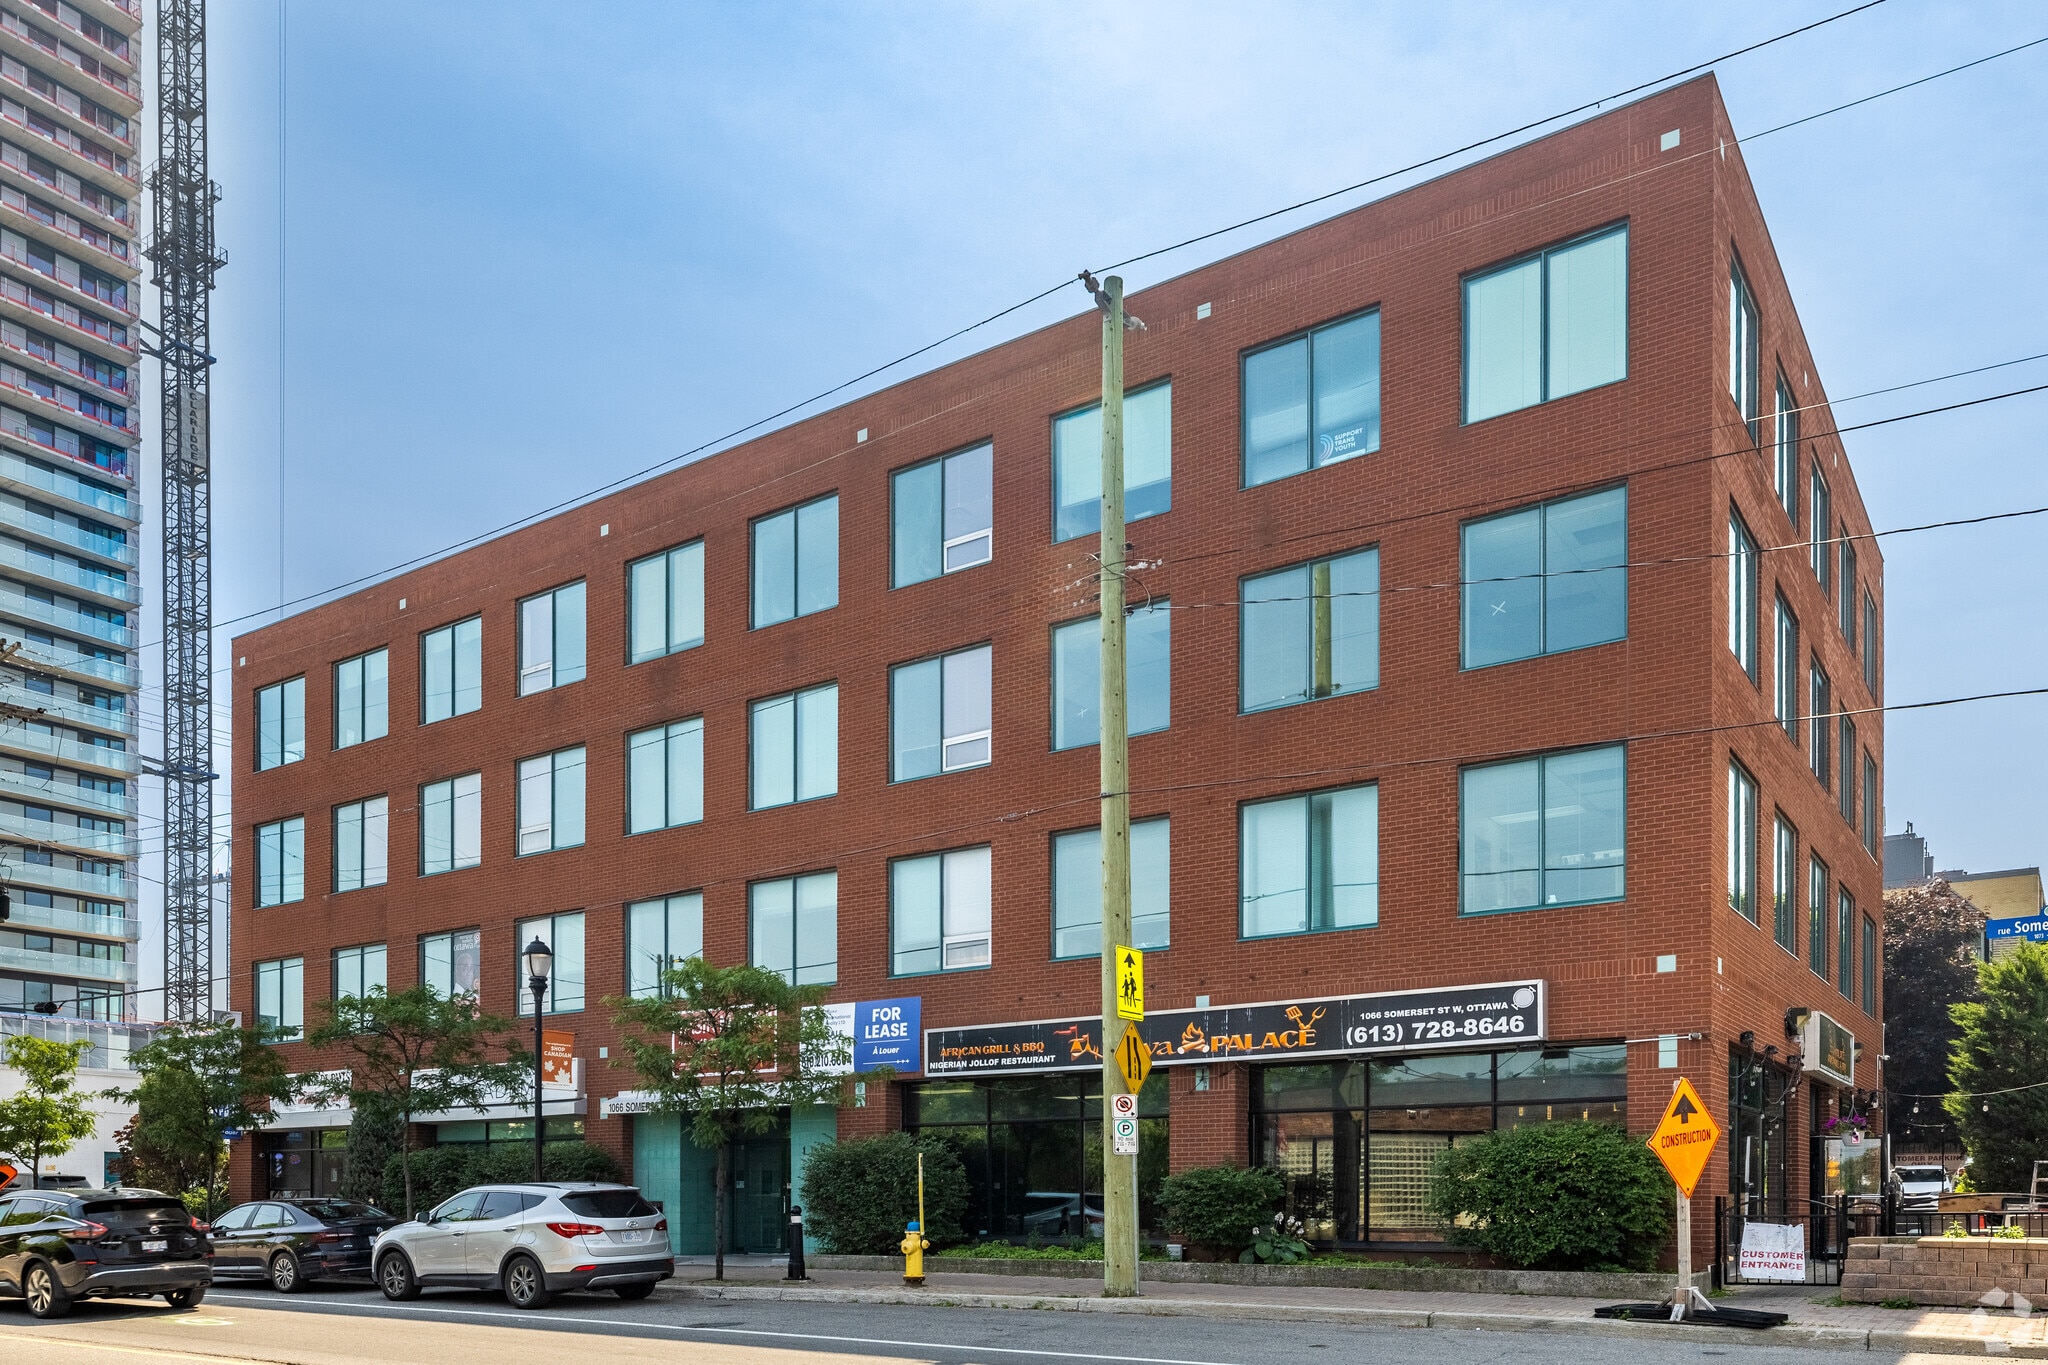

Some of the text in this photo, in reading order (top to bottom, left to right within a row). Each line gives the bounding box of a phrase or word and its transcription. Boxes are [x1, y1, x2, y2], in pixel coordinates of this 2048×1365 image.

[189, 392, 199, 461] CLARIDGE
[1334, 427, 1363, 441] SUPPORT
[1335, 436, 1355, 446] TRANS
[1335, 442, 1356, 452] YOUTH
[872, 1007, 901, 1022] FOR
[1360, 1002, 1508, 1020] 1066 SOMERSET ST W, OTTAWA
[865, 1023, 908, 1039] LEASE
[1346, 1015, 1525, 1045] (613) 728-8646
[1211, 1029, 1316, 1052] PALACE
[872, 1046, 878, 1055] À
[940, 1046, 981, 1059] AFRICAN
[983, 1044, 1011, 1054] GRILL
[1014, 1043, 1020, 1055] &
[1022, 1042, 1045, 1052] BBQ
[929, 1055, 1056, 1069] NIGERIAN JOLLOF RESTAURANT
[609, 1102, 623, 1112] 1066
[1122, 1124, 1130, 1132] P
[1661, 1129, 1711, 1148] CONSTRUCTION
[1741, 1251, 1803, 1260] CUSTOMER
[1741, 1261, 1803, 1270] ENTRANCE
